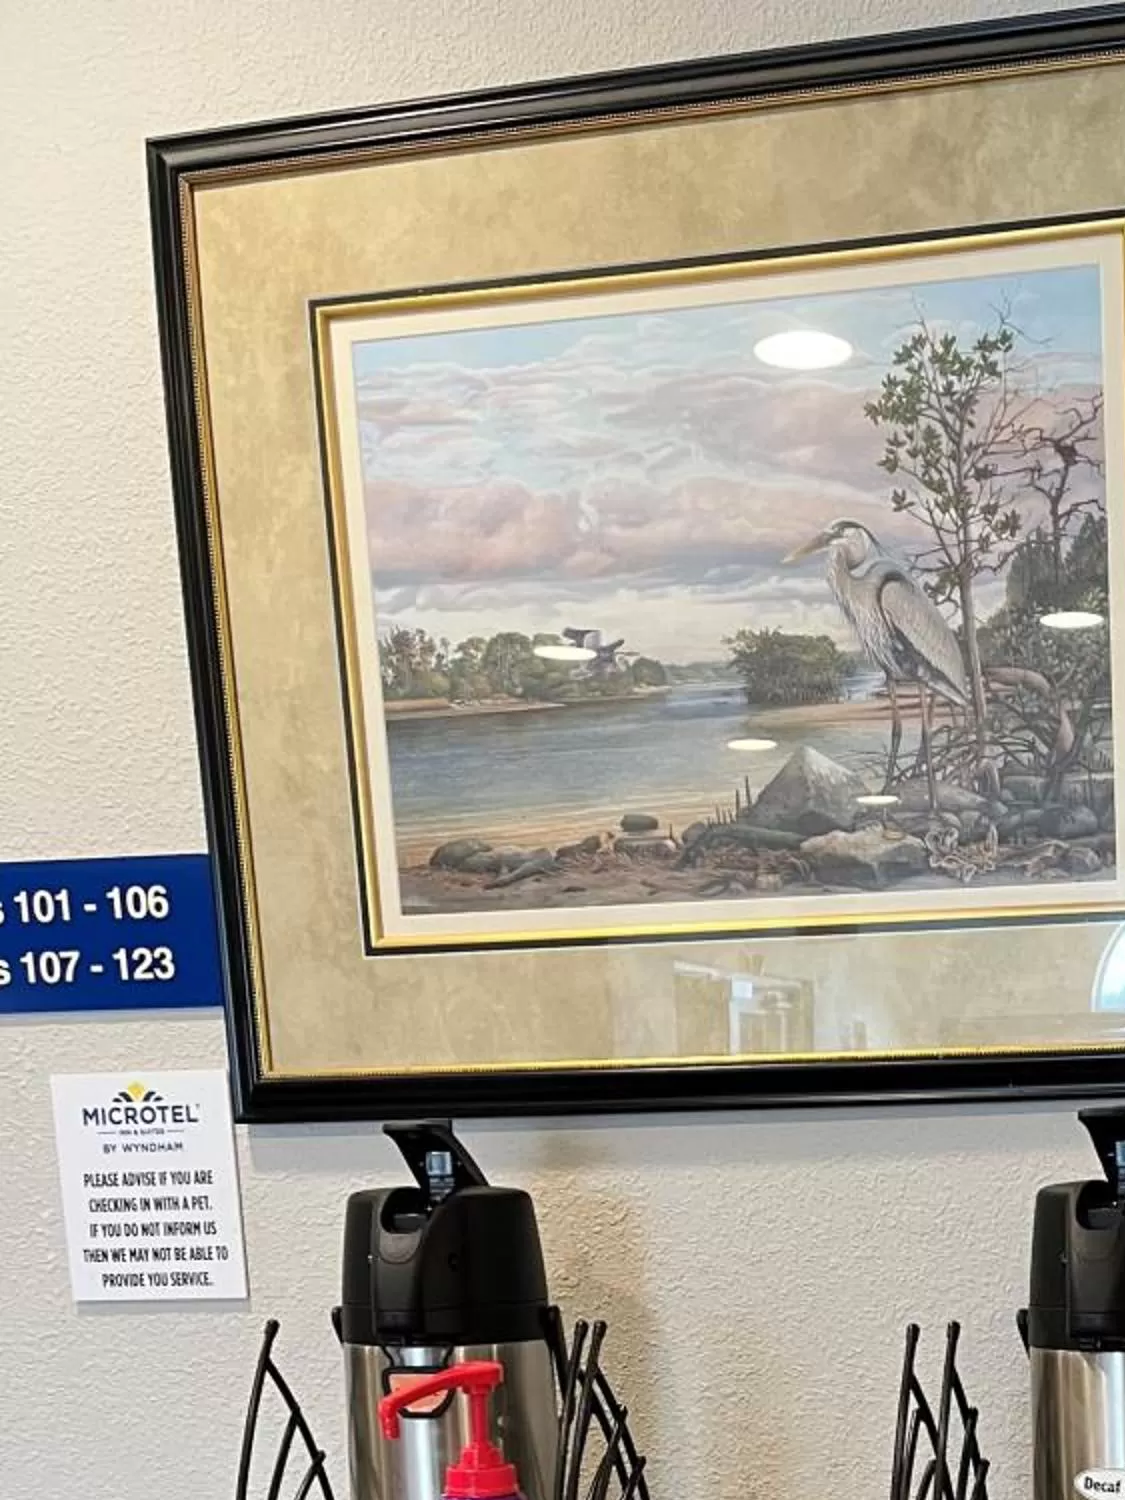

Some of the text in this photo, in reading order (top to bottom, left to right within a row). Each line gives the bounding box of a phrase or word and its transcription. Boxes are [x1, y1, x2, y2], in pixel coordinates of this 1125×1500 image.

[13, 888, 71, 923] 101
[83, 903, 97, 912] -
[106, 884, 169, 919] 106
[20, 951, 80, 984] 107
[90, 964, 104, 973] -
[112, 947, 175, 981] 123
[82, 1105, 199, 1126] MICROTEL
[103, 1142, 183, 1153] BY WYNDHAM
[83, 1170, 213, 1187] PLEASE ADVISE IF YOU ARE
[89, 1198, 138, 1212] CHECKING
[139, 1197, 151, 1211] IN
[153, 1196, 180, 1211] WITH
[182, 1196, 190, 1210] A
[89, 1221, 217, 1238] IF YOU DO NOT INFORM US
[83, 1245, 229, 1263] THEN WE MAY NOT BE ABLE TO
[102, 1273, 144, 1288] PROVIDE
[147, 1272, 168, 1287] YOU
[1084, 1476, 1121, 1493] Decaf
